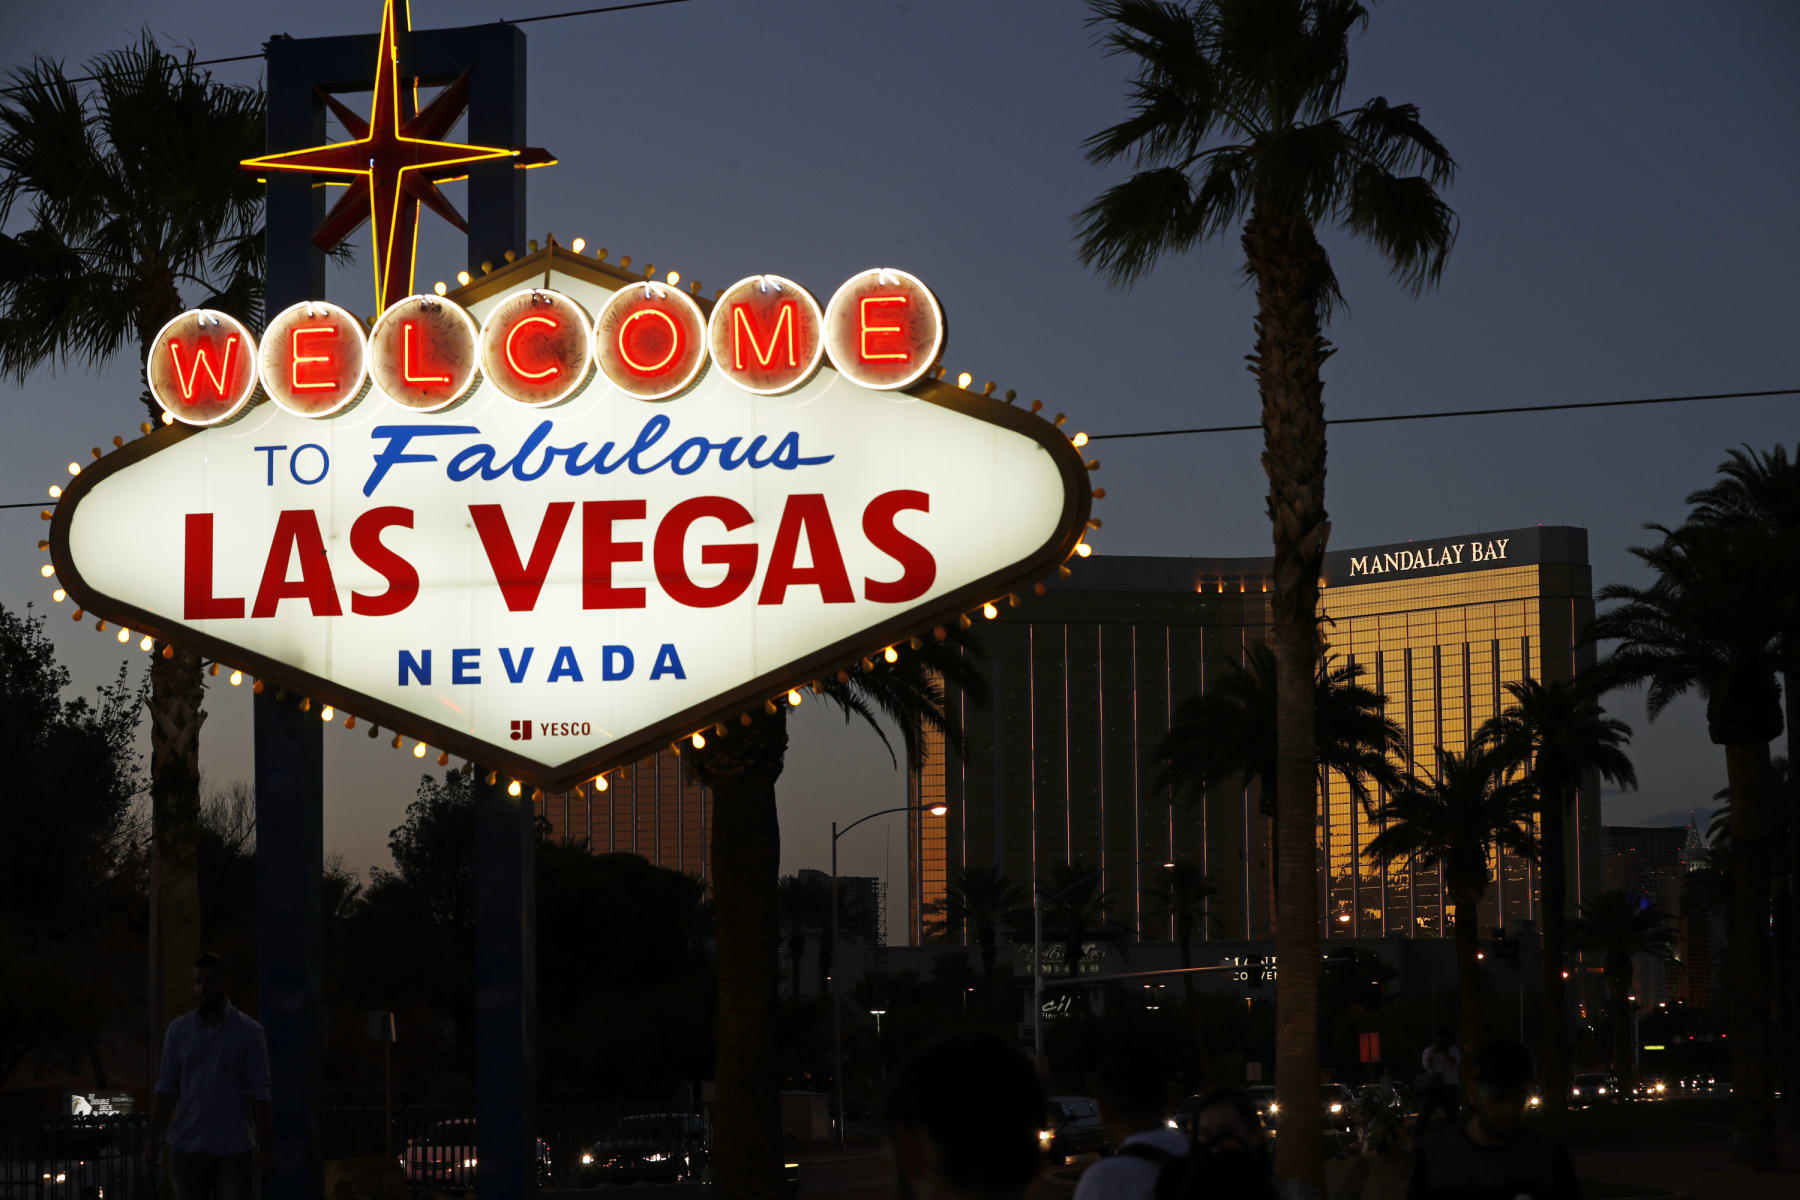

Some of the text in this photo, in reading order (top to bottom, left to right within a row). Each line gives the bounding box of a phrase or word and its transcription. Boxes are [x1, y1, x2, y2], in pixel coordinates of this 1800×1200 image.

[167, 294, 910, 404] WELCOME
[254, 413, 835, 497] TO Fabulous
[183, 489, 937, 620] LAS VEGAS
[1349, 538, 1510, 577] MANDALAY BAY
[399, 643, 686, 686] NEVADA
[541, 722, 591, 737] YESCO
